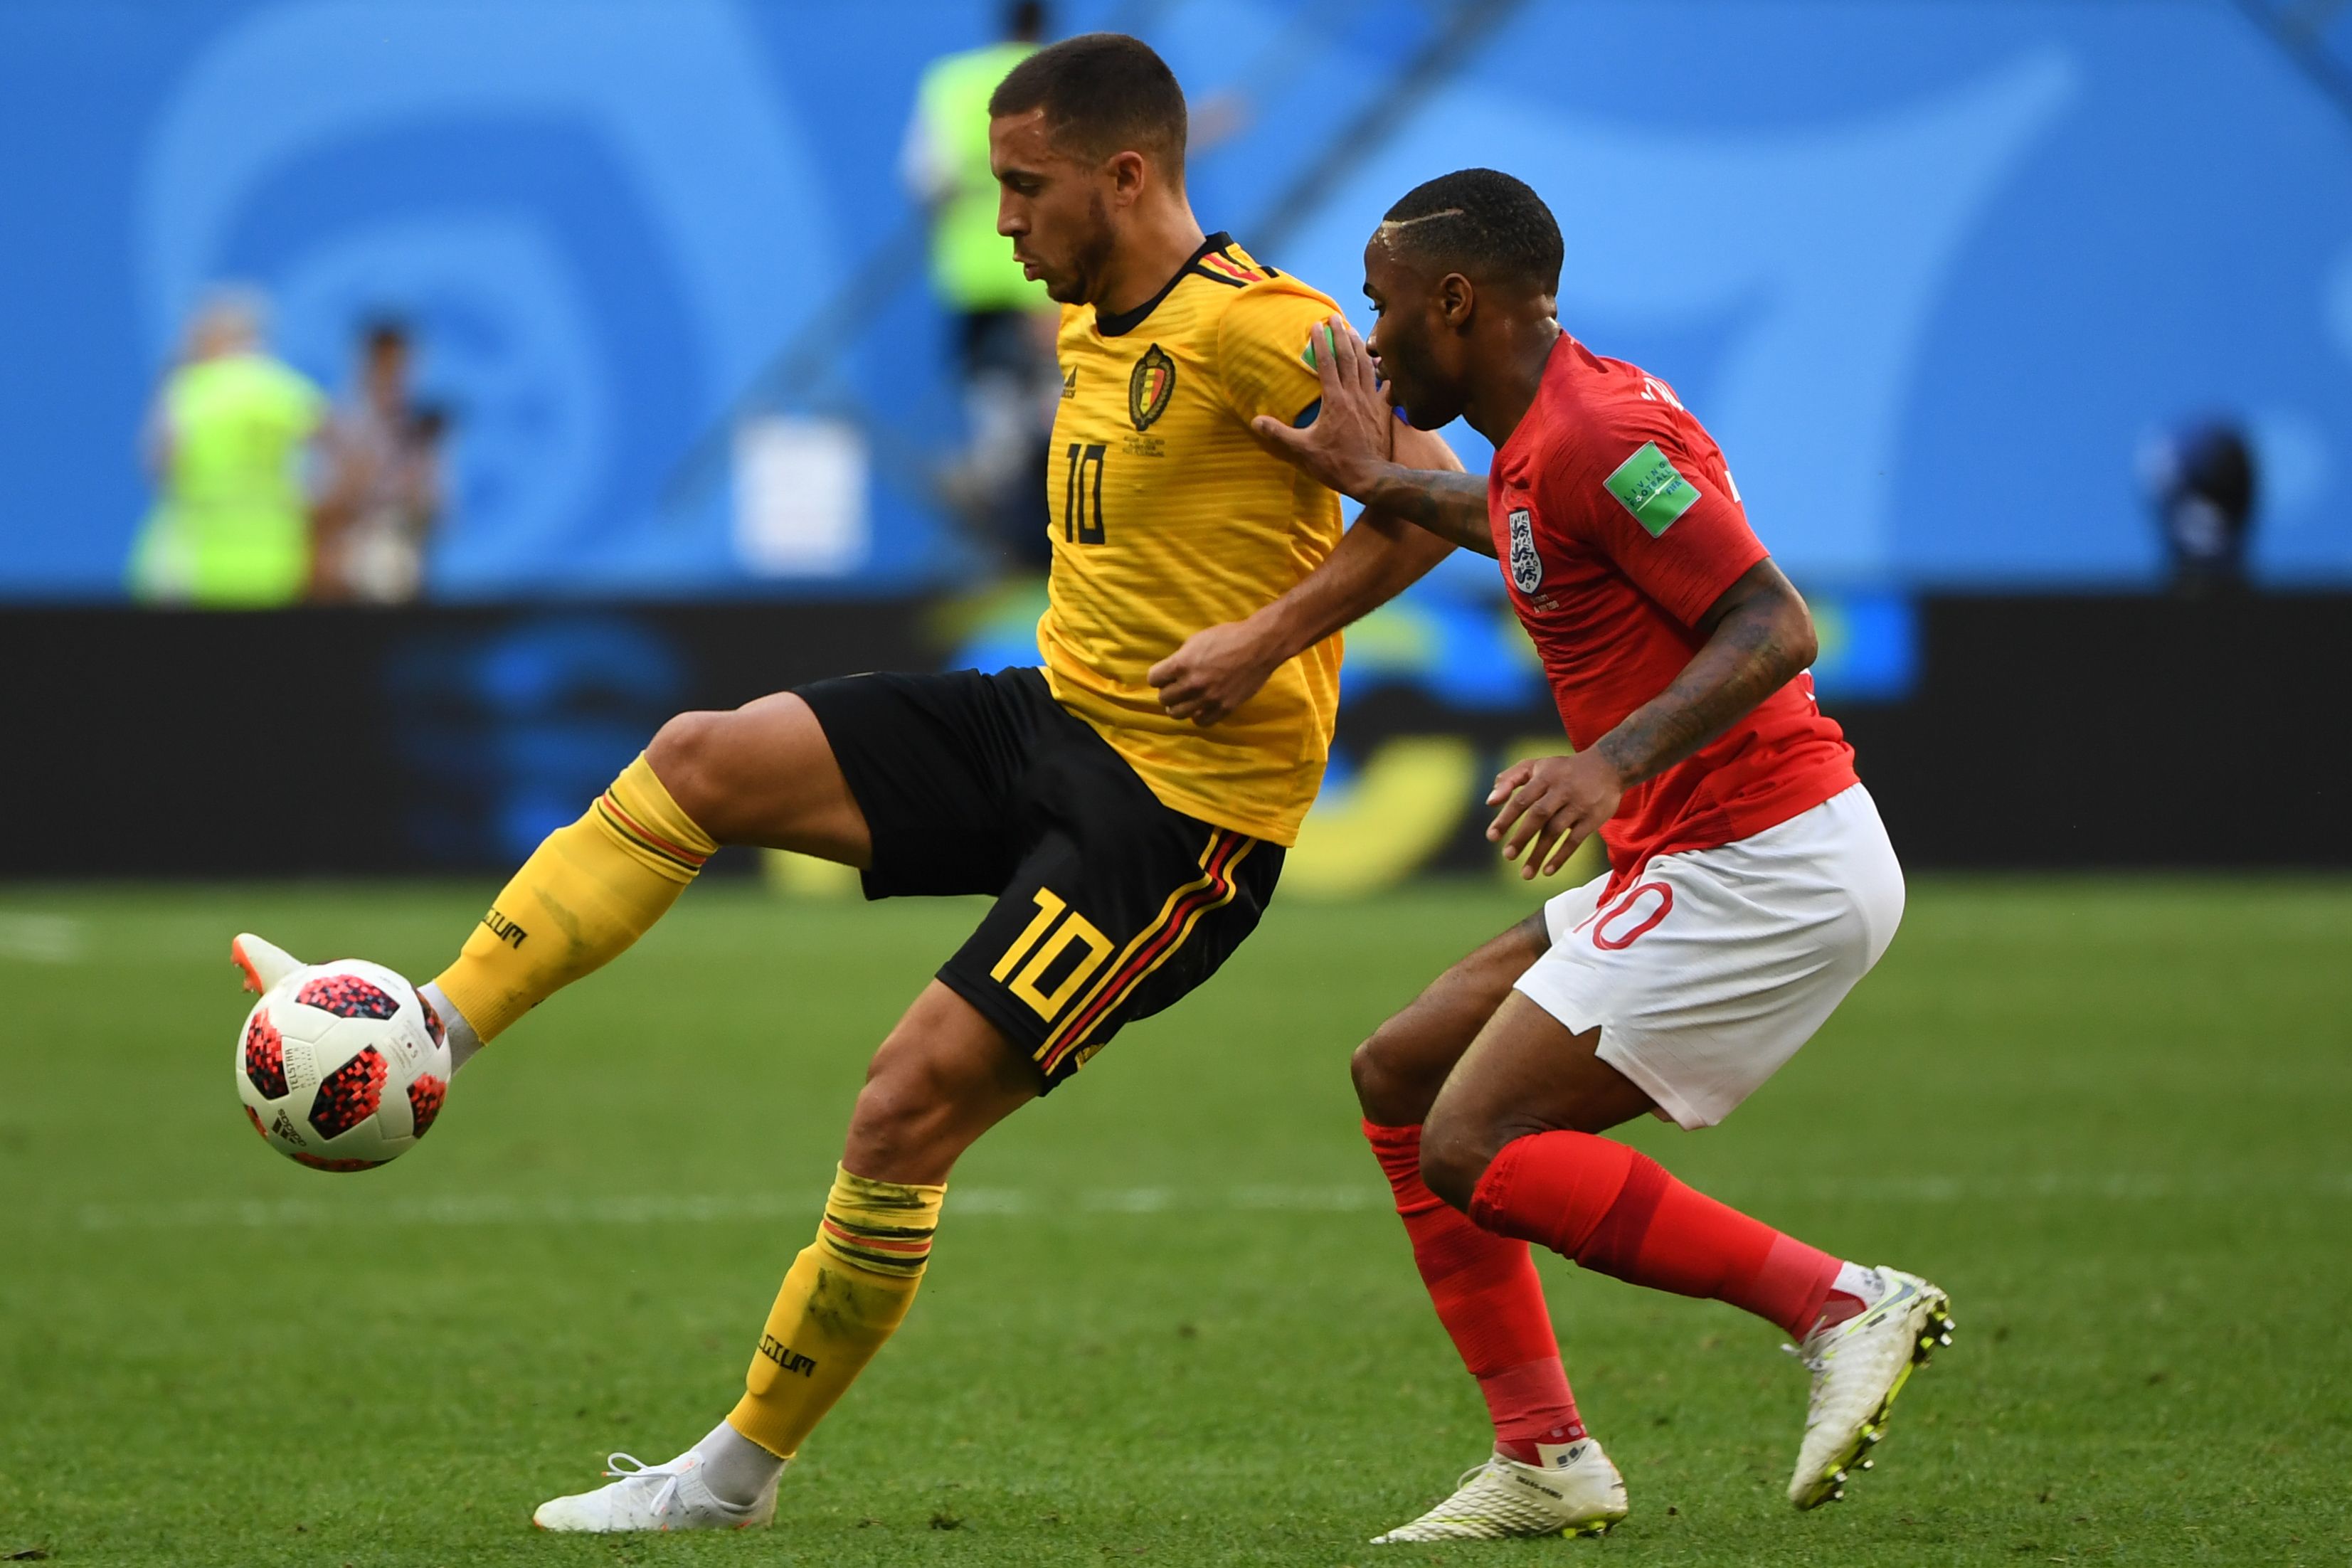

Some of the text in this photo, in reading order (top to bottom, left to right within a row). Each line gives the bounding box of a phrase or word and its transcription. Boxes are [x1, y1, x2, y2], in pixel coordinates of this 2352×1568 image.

[1066, 443, 1107, 545] 10
[1623, 460, 1668, 502] LIVING
[1665, 480, 1682, 496] FIFA
[990, 886, 1116, 1024] 10
[278, 1108, 307, 1147] adidas
